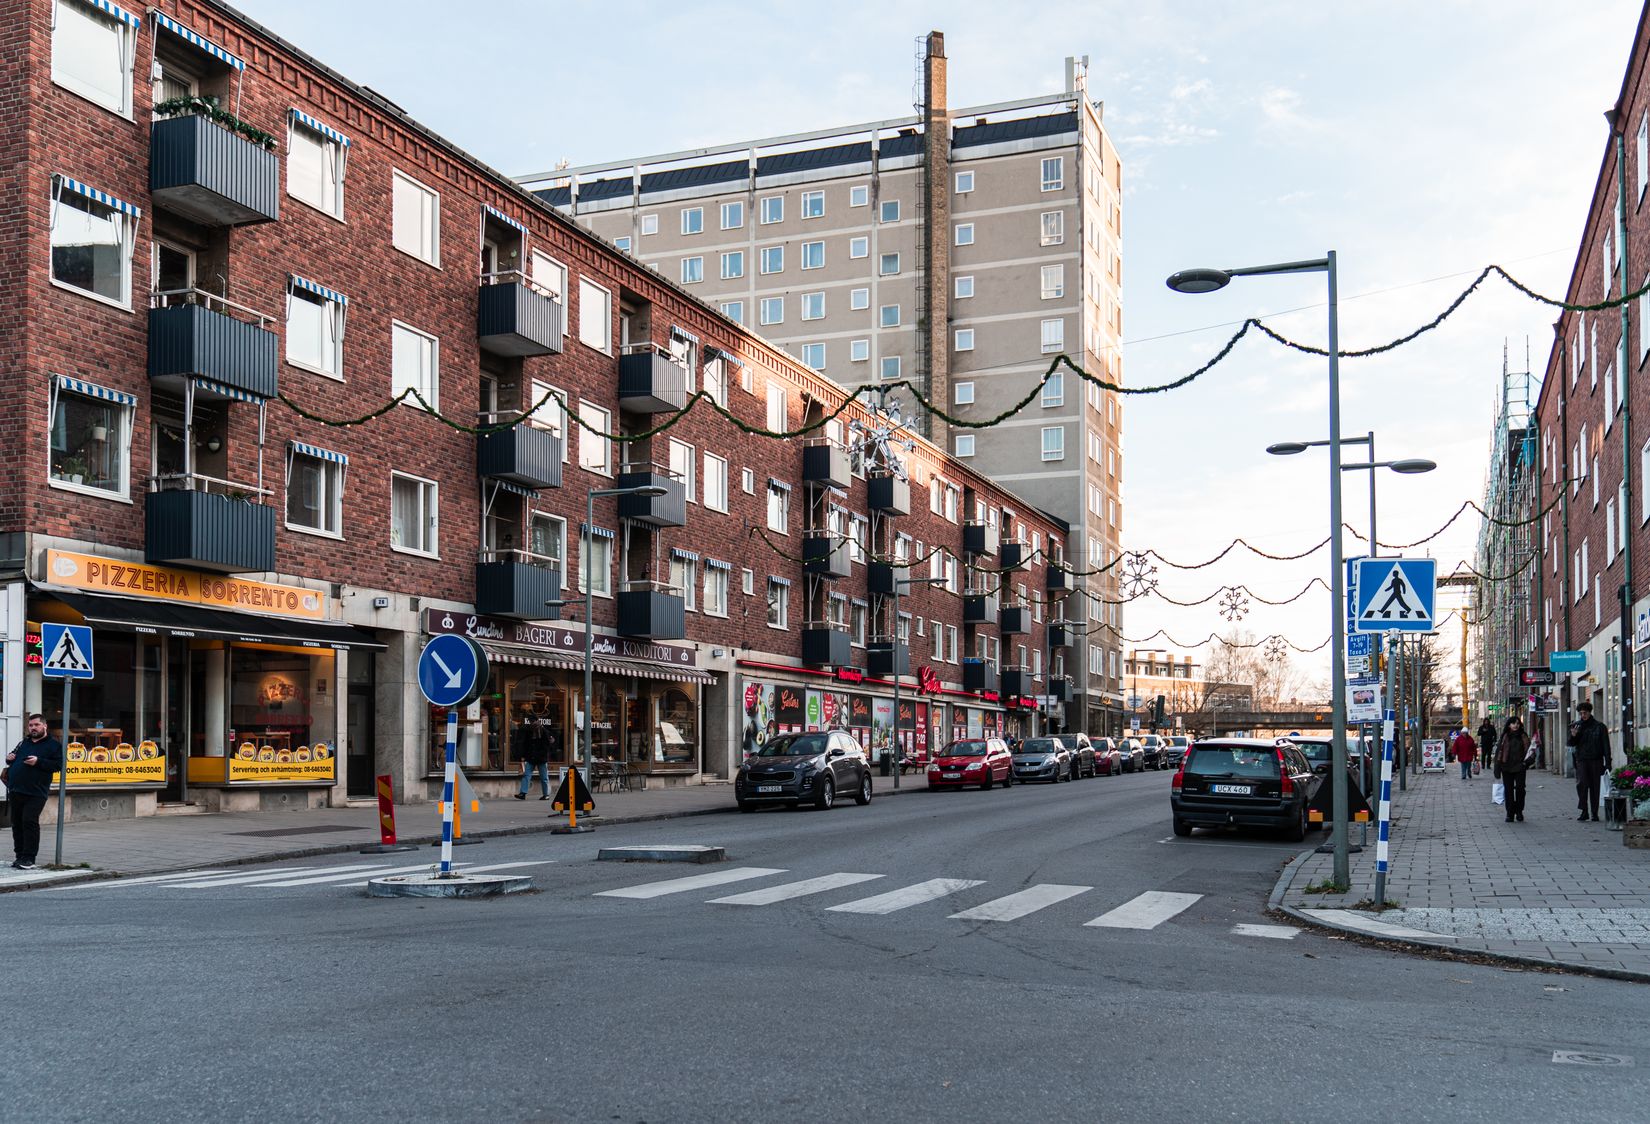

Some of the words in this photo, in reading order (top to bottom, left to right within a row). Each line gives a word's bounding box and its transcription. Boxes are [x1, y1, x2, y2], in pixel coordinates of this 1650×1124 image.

[87, 562, 190, 596] PIZZERIA
[202, 579, 299, 610] SORRENTO
[135, 626, 157, 634] PIZZERIA
[465, 616, 504, 640] Lundins
[516, 624, 556, 646] BAGERI
[623, 641, 672, 661] KONDITORI
[66, 766, 79, 775] och
[125, 766, 162, 774] 08-6463040
[232, 766, 259, 774] Servering
[1233, 786, 1248, 794] 460
